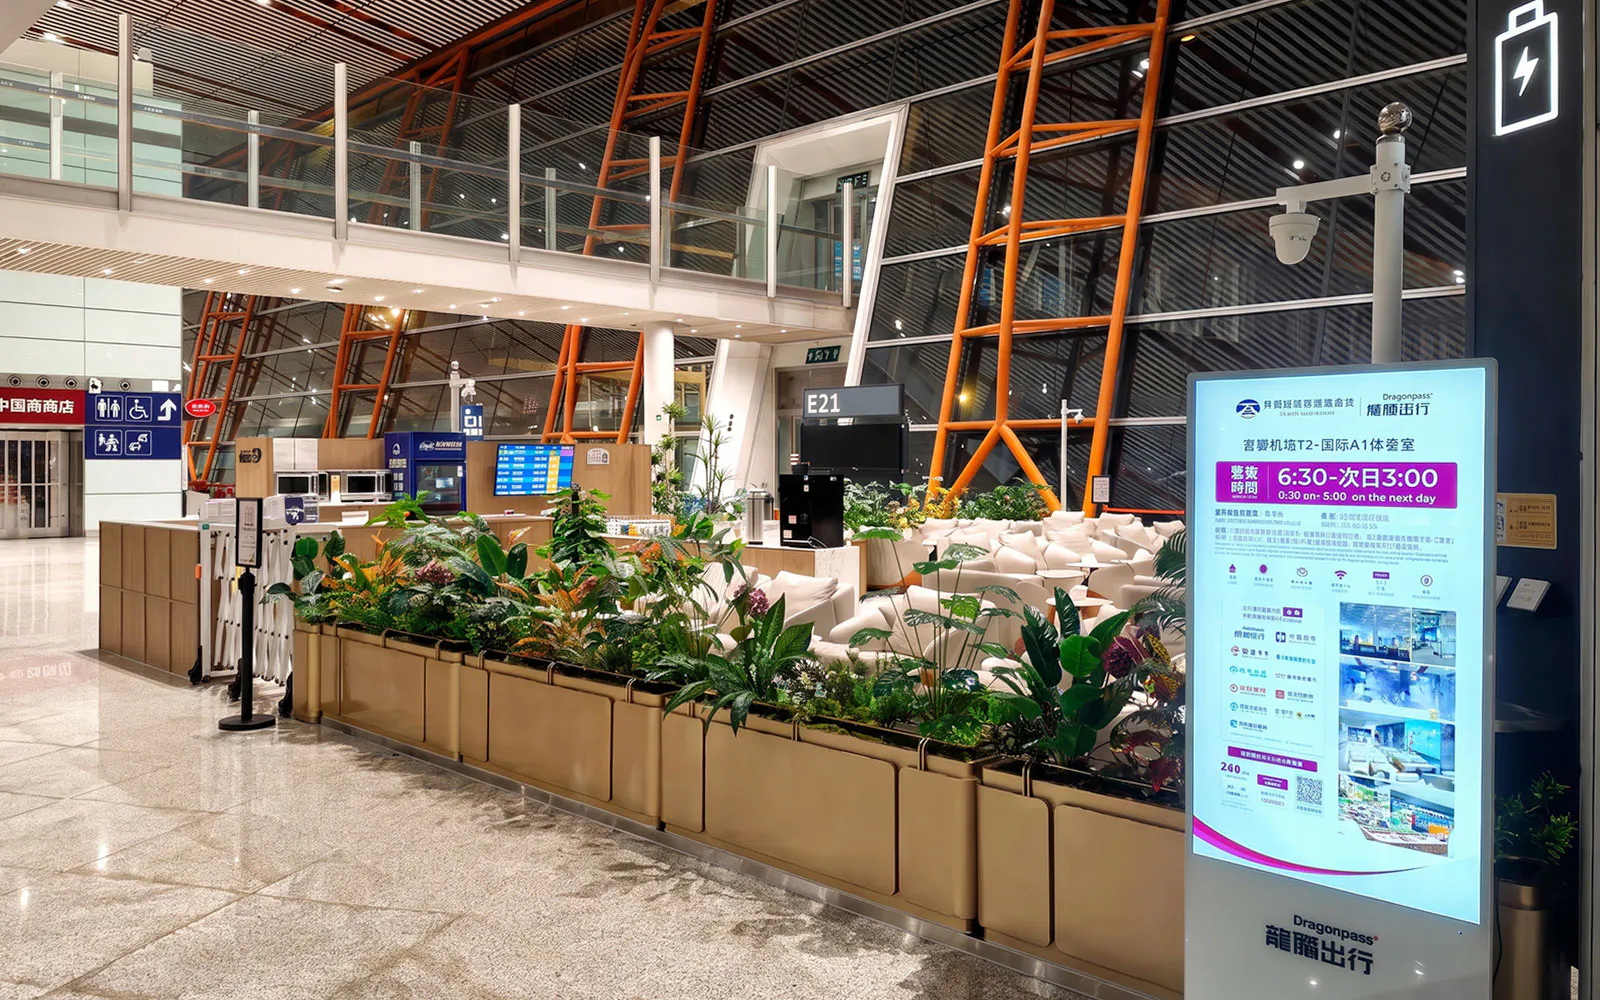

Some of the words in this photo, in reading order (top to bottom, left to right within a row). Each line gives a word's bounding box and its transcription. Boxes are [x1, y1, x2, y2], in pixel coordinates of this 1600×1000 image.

[807, 393, 840, 413] E21
[1383, 393, 1431, 402] Dragonpass
[1278, 490, 1301, 500] 0:30
[1352, 494, 1366, 502] on
[1368, 493, 1386, 502] the
[1389, 494, 1413, 503] next
[1415, 493, 1436, 505] day
[1293, 914, 1374, 946] Dragonpass
